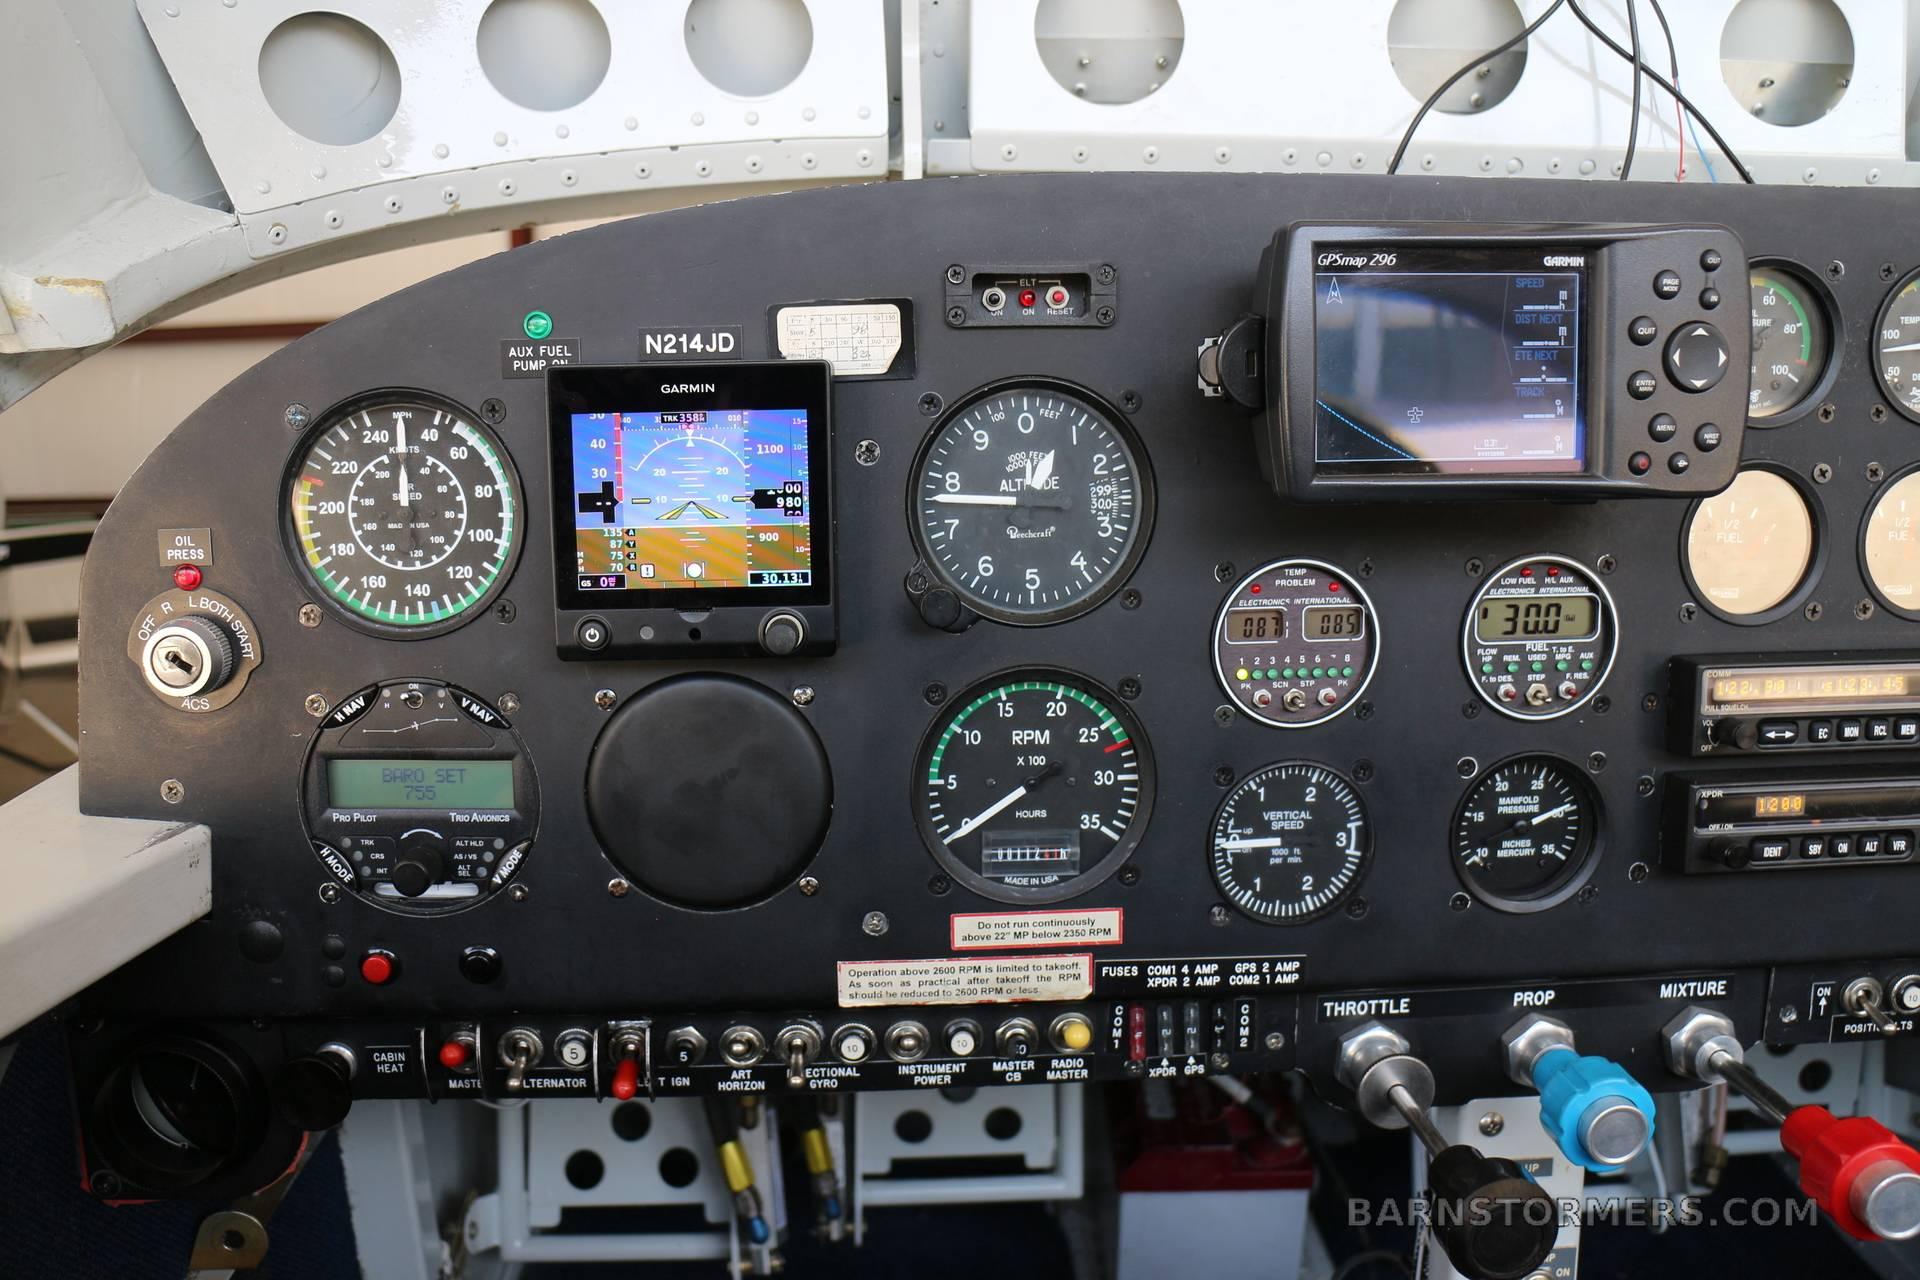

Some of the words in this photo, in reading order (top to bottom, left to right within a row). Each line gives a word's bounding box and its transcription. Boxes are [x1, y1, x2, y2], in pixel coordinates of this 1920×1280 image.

[1318, 254, 1367, 268] GPSmap
[1369, 254, 1397, 266] 296
[1544, 256, 1584, 267] GARMIN
[1515, 278, 1544, 288] SPEED
[1047, 308, 1073, 316] RESET
[1515, 314, 1536, 324] DIST
[1540, 314, 1563, 324] NEXT
[646, 333, 735, 354] N214JD
[509, 346, 534, 357] AUX
[540, 346, 572, 357] FUEL
[1515, 351, 1532, 360] ETE
[1535, 350, 1558, 360] NEXT
[514, 360, 545, 371] PUMP
[661, 384, 715, 393] GARMIN
[1040, 409, 1060, 420] FEET
[757, 444, 783, 454] 1100
[332, 462, 357, 474] 220
[475, 485, 492, 497] 80
[777, 497, 801, 507] 980
[319, 502, 345, 514] 200
[176, 536, 195, 546] OIL
[468, 529, 493, 542] 100
[759, 533, 778, 542] 900
[1717, 533, 1742, 543] FUEL
[168, 549, 204, 560] PRESS
[330, 544, 354, 556] 180
[447, 566, 472, 578] 120
[361, 576, 386, 588] 160
[405, 584, 430, 596] 140
[200, 597, 234, 622] BOTH
[138, 614, 156, 640] OFF
[1243, 617, 1282, 638] 087
[232, 620, 254, 660] START
[1526, 643, 1549, 651] FUEL
[181, 698, 209, 710] ACS
[334, 711, 345, 722] H
[343, 696, 365, 717] NAV
[1046, 702, 1066, 716] 20
[461, 698, 472, 708] V
[470, 704, 494, 723] NAV
[998, 703, 1014, 717] 15
[1079, 729, 1098, 742] 25
[1844, 727, 1859, 738] MON
[1874, 726, 1887, 736] RCL
[1901, 724, 1916, 736] MEM
[964, 731, 981, 745] 10
[1012, 730, 1050, 745] RPM
[382, 769, 424, 783] BARO
[435, 769, 466, 783] SET
[1094, 771, 1114, 785] 30
[404, 786, 436, 800] 755
[1701, 790, 1723, 798] XPDR
[1499, 796, 1539, 804] MANIFOLD
[1758, 797, 1802, 812] 1200
[1016, 810, 1046, 818] HOURS
[1498, 805, 1539, 814] PRESSURE
[1263, 811, 1312, 821] VERTICAL
[1081, 815, 1100, 829] 35
[1271, 821, 1304, 830] SPEED
[1502, 840, 1531, 848] INCHES
[1809, 844, 1822, 855] SBY
[1865, 842, 1878, 852] ALT
[1893, 840, 1906, 851] VFR
[1497, 848, 1535, 857] MERCURY
[1763, 847, 1782, 858] IDENT
[320, 847, 330, 857] H
[327, 854, 353, 882] MODE
[493, 874, 503, 884] V
[500, 849, 522, 876] MODE
[1005, 876, 1028, 884] MADE
[1041, 875, 1058, 884] USA
[978, 921, 991, 930] Do
[994, 920, 1010, 929] not
[1032, 917, 1096, 930] continuously
[962, 932, 991, 942] above
[1014, 930, 1029, 939] MP
[1032, 929, 1060, 939] below
[1064, 928, 1086, 938] 2350
[1089, 928, 1112, 937] RPM
[848, 968, 897, 980] Operation
[900, 966, 930, 976] above
[933, 966, 955, 975] 2600
[959, 965, 982, 974] RPM
[985, 964, 993, 973] is
[996, 963, 1029, 973] limited
[1032, 963, 1042, 971] to
[1045, 962, 1081, 971] takeoff.
[1102, 966, 1138, 977] FUSES
[1147, 965, 1176, 975] COM1
[1181, 965, 1189, 974] 4
[1194, 964, 1218, 974] AMP
[1235, 962, 1256, 973] GPS
[1263, 962, 1269, 972] 2
[1275, 961, 1300, 972] AMP
[849, 979, 862, 988] As
[918, 976, 960, 988] practical
[967, 976, 989, 985] after
[996, 975, 1030, 984] takeoff
[1036, 974, 1052, 983] the
[1058, 972, 1081, 981] RPM
[1147, 977, 1177, 987] XPDR
[1183, 977, 1190, 986] 2
[1196, 976, 1220, 986] AMP
[1229, 974, 1260, 985] COM2
[1266, 974, 1270, 984] 1
[1275, 973, 1299, 984] AMP
[849, 989, 882, 999] should
[886, 988, 898, 998] be
[900, 988, 939, 998] reduced
[942, 988, 952, 996] to
[955, 987, 977, 996] 2600
[980, 986, 1003, 995] RPM
[1006, 986, 1016, 994] or
[1660, 980, 1727, 999] MIXTURE
[1513, 990, 1555, 1007] PROP
[1324, 998, 1410, 1017] THROTTLE
[373, 1052, 406, 1063] CABIN
[1052, 1058, 1084, 1068] RADIO
[377, 1063, 404, 1073] HEAT
[898, 1063, 967, 1075] INSTRUMENT
[993, 1061, 1034, 1071] MASTER
[1149, 1067, 1176, 1078] XPDR
[1184, 1065, 1205, 1075] GPS
[731, 1070, 752, 1080] ART
[914, 1075, 951, 1085] POWER
[1006, 1072, 1022, 1082] CB
[1047, 1070, 1088, 1080] MASTER
[672, 1077, 690, 1086] IGN
[718, 1080, 766, 1092] HORIZON
[810, 1079, 838, 1088] GYRO
